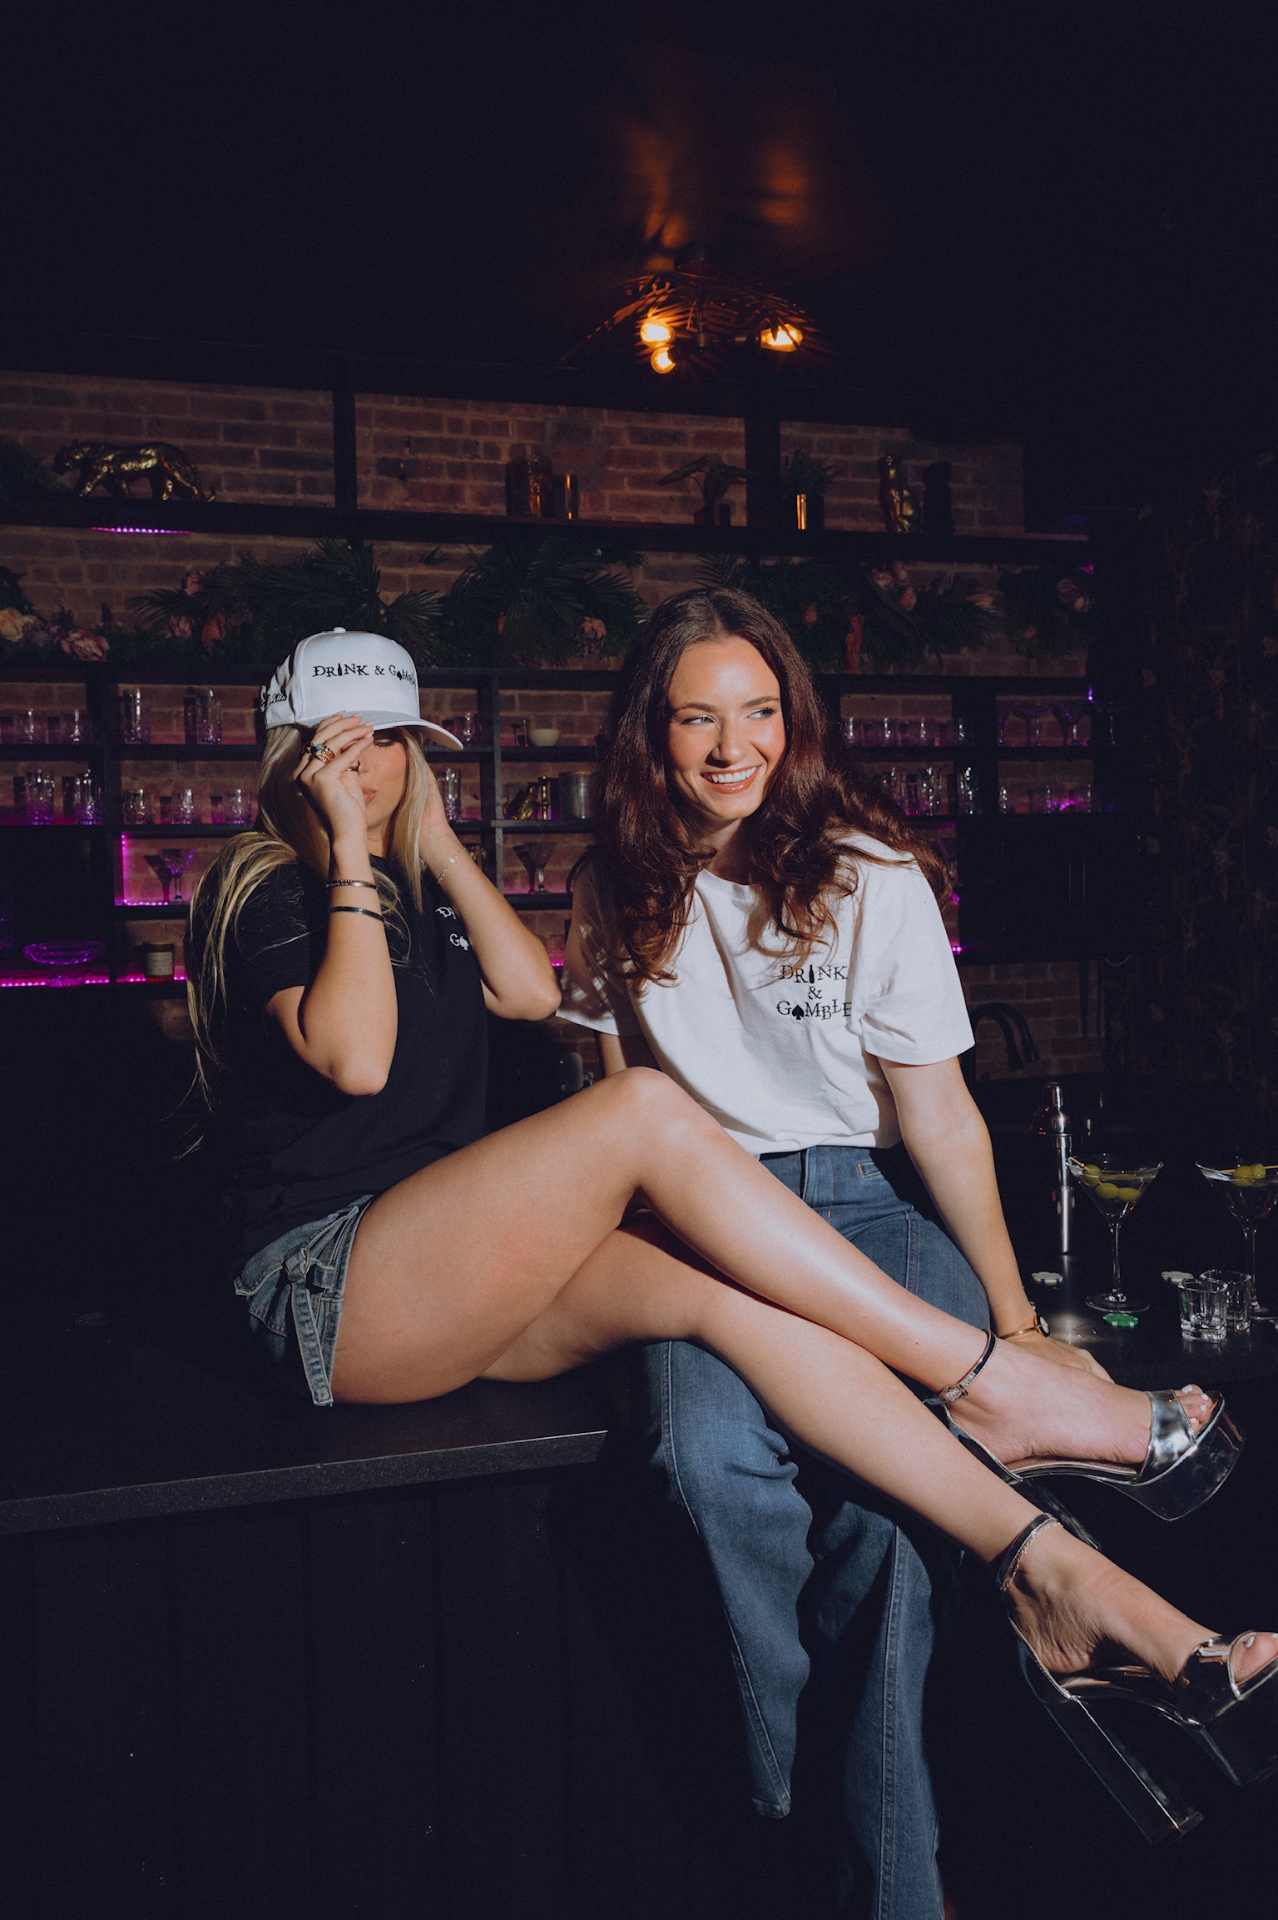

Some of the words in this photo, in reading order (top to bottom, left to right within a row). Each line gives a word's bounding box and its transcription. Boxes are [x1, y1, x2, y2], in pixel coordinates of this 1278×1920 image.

[374, 665, 385, 675] &
[780, 964, 848, 984] DRINK
[808, 986, 822, 999] &
